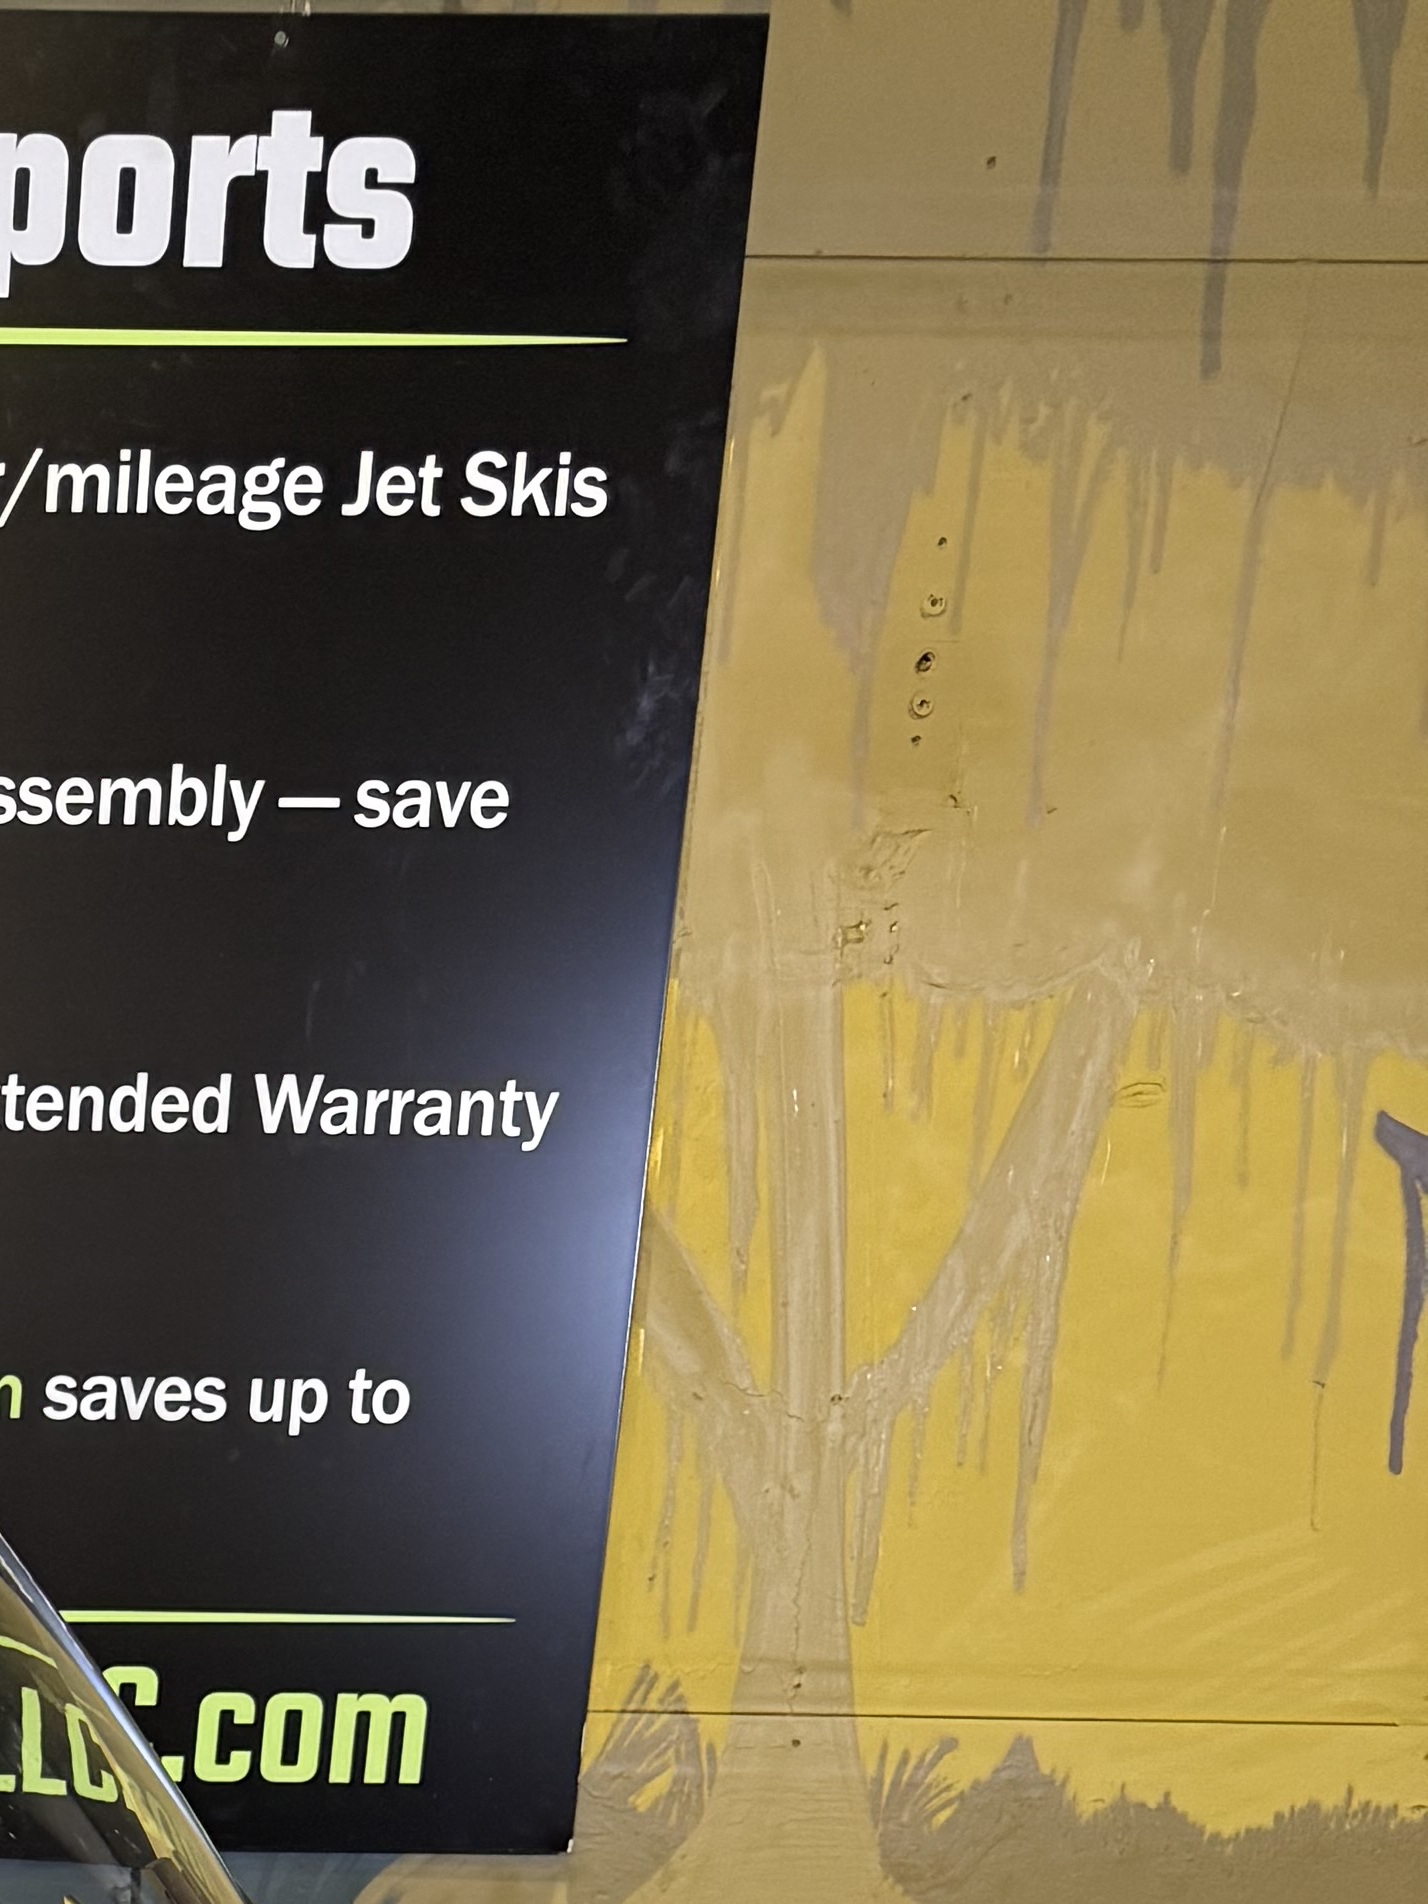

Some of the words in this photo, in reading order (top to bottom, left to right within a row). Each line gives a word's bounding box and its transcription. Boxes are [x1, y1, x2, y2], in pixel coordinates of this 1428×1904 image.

[342, 451, 443, 516] Jet
[461, 451, 607, 517] Skis
[354, 780, 509, 828] save
[255, 1074, 559, 1151] Warranty
[43, 1375, 226, 1421] saves
[250, 1378, 328, 1436] up
[349, 1369, 410, 1424] to
